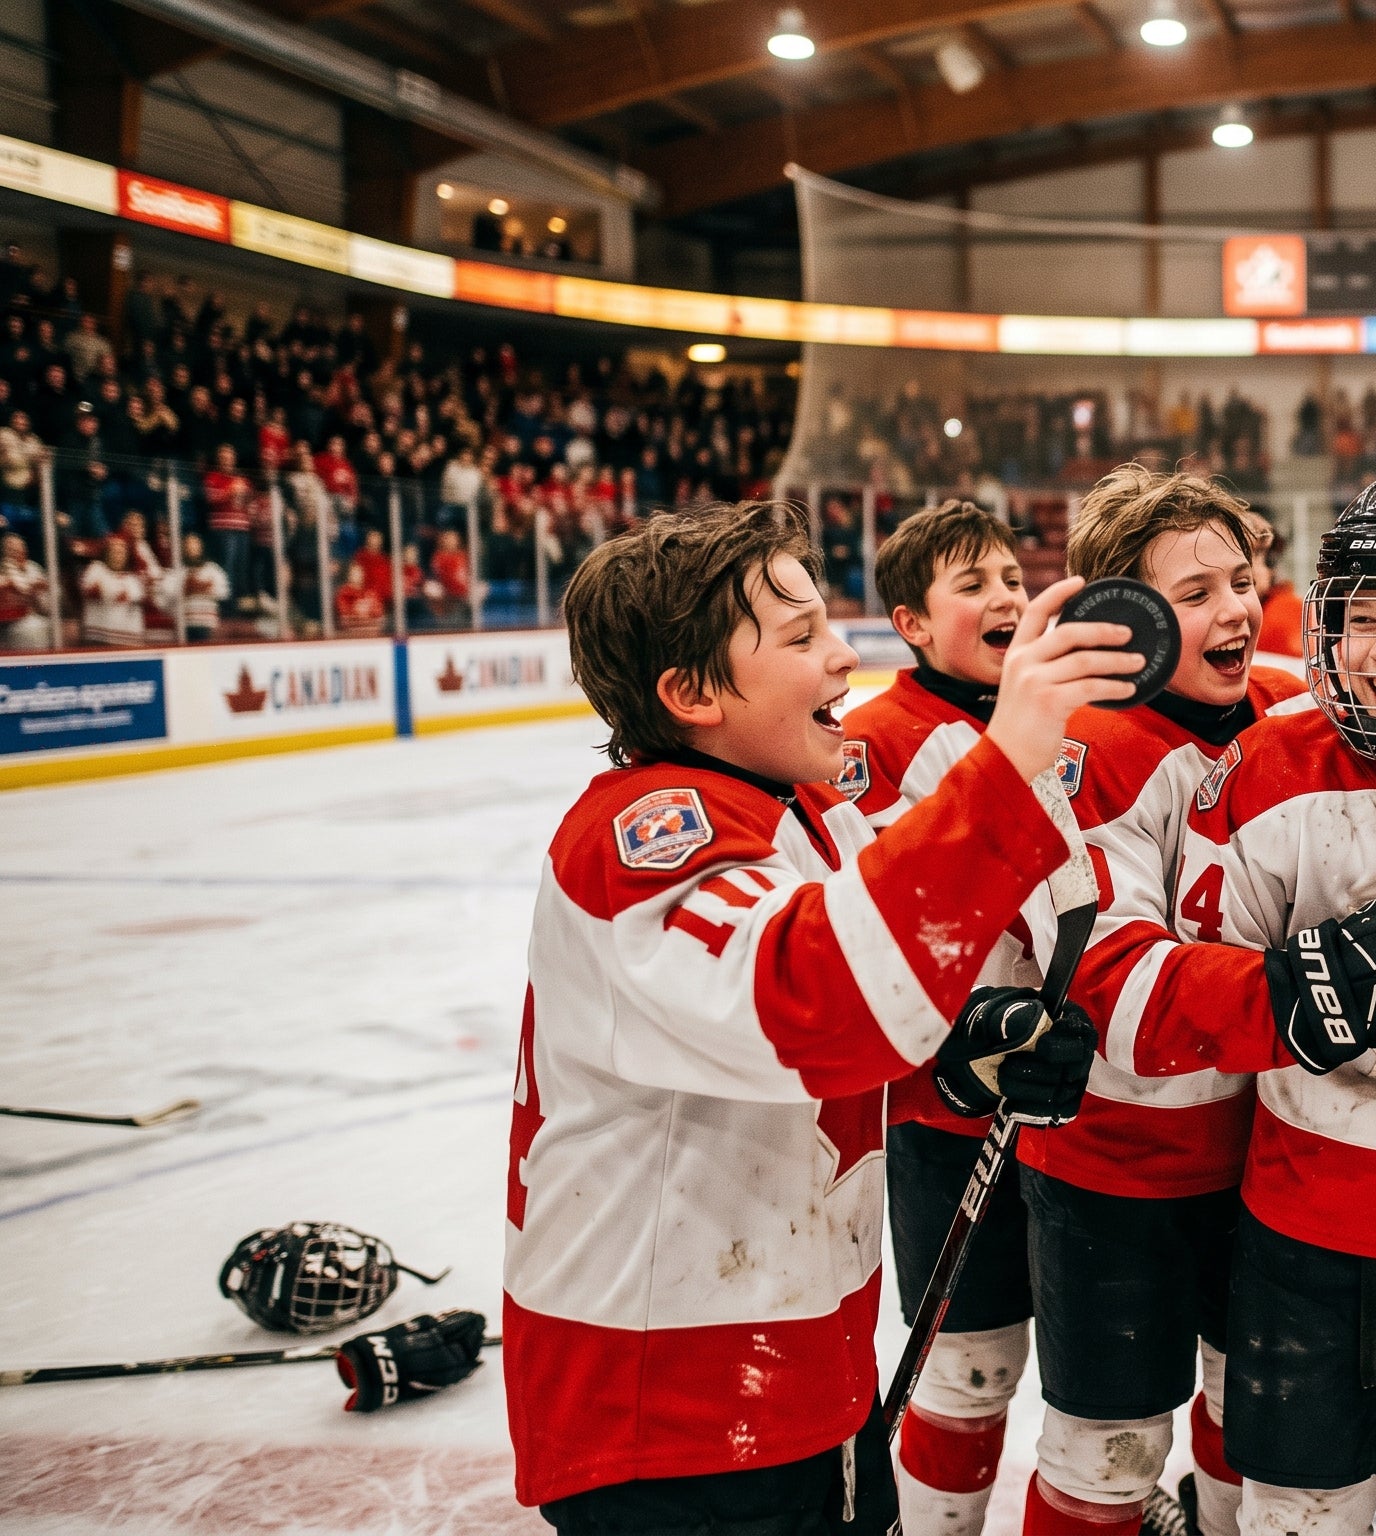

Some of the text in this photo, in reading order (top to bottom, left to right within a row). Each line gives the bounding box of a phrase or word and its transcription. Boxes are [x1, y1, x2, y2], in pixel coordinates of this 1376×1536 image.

[271, 662, 379, 712] CANADIAN
[1174, 854, 1225, 942] 4
[1298, 927, 1356, 1045] BAUE
